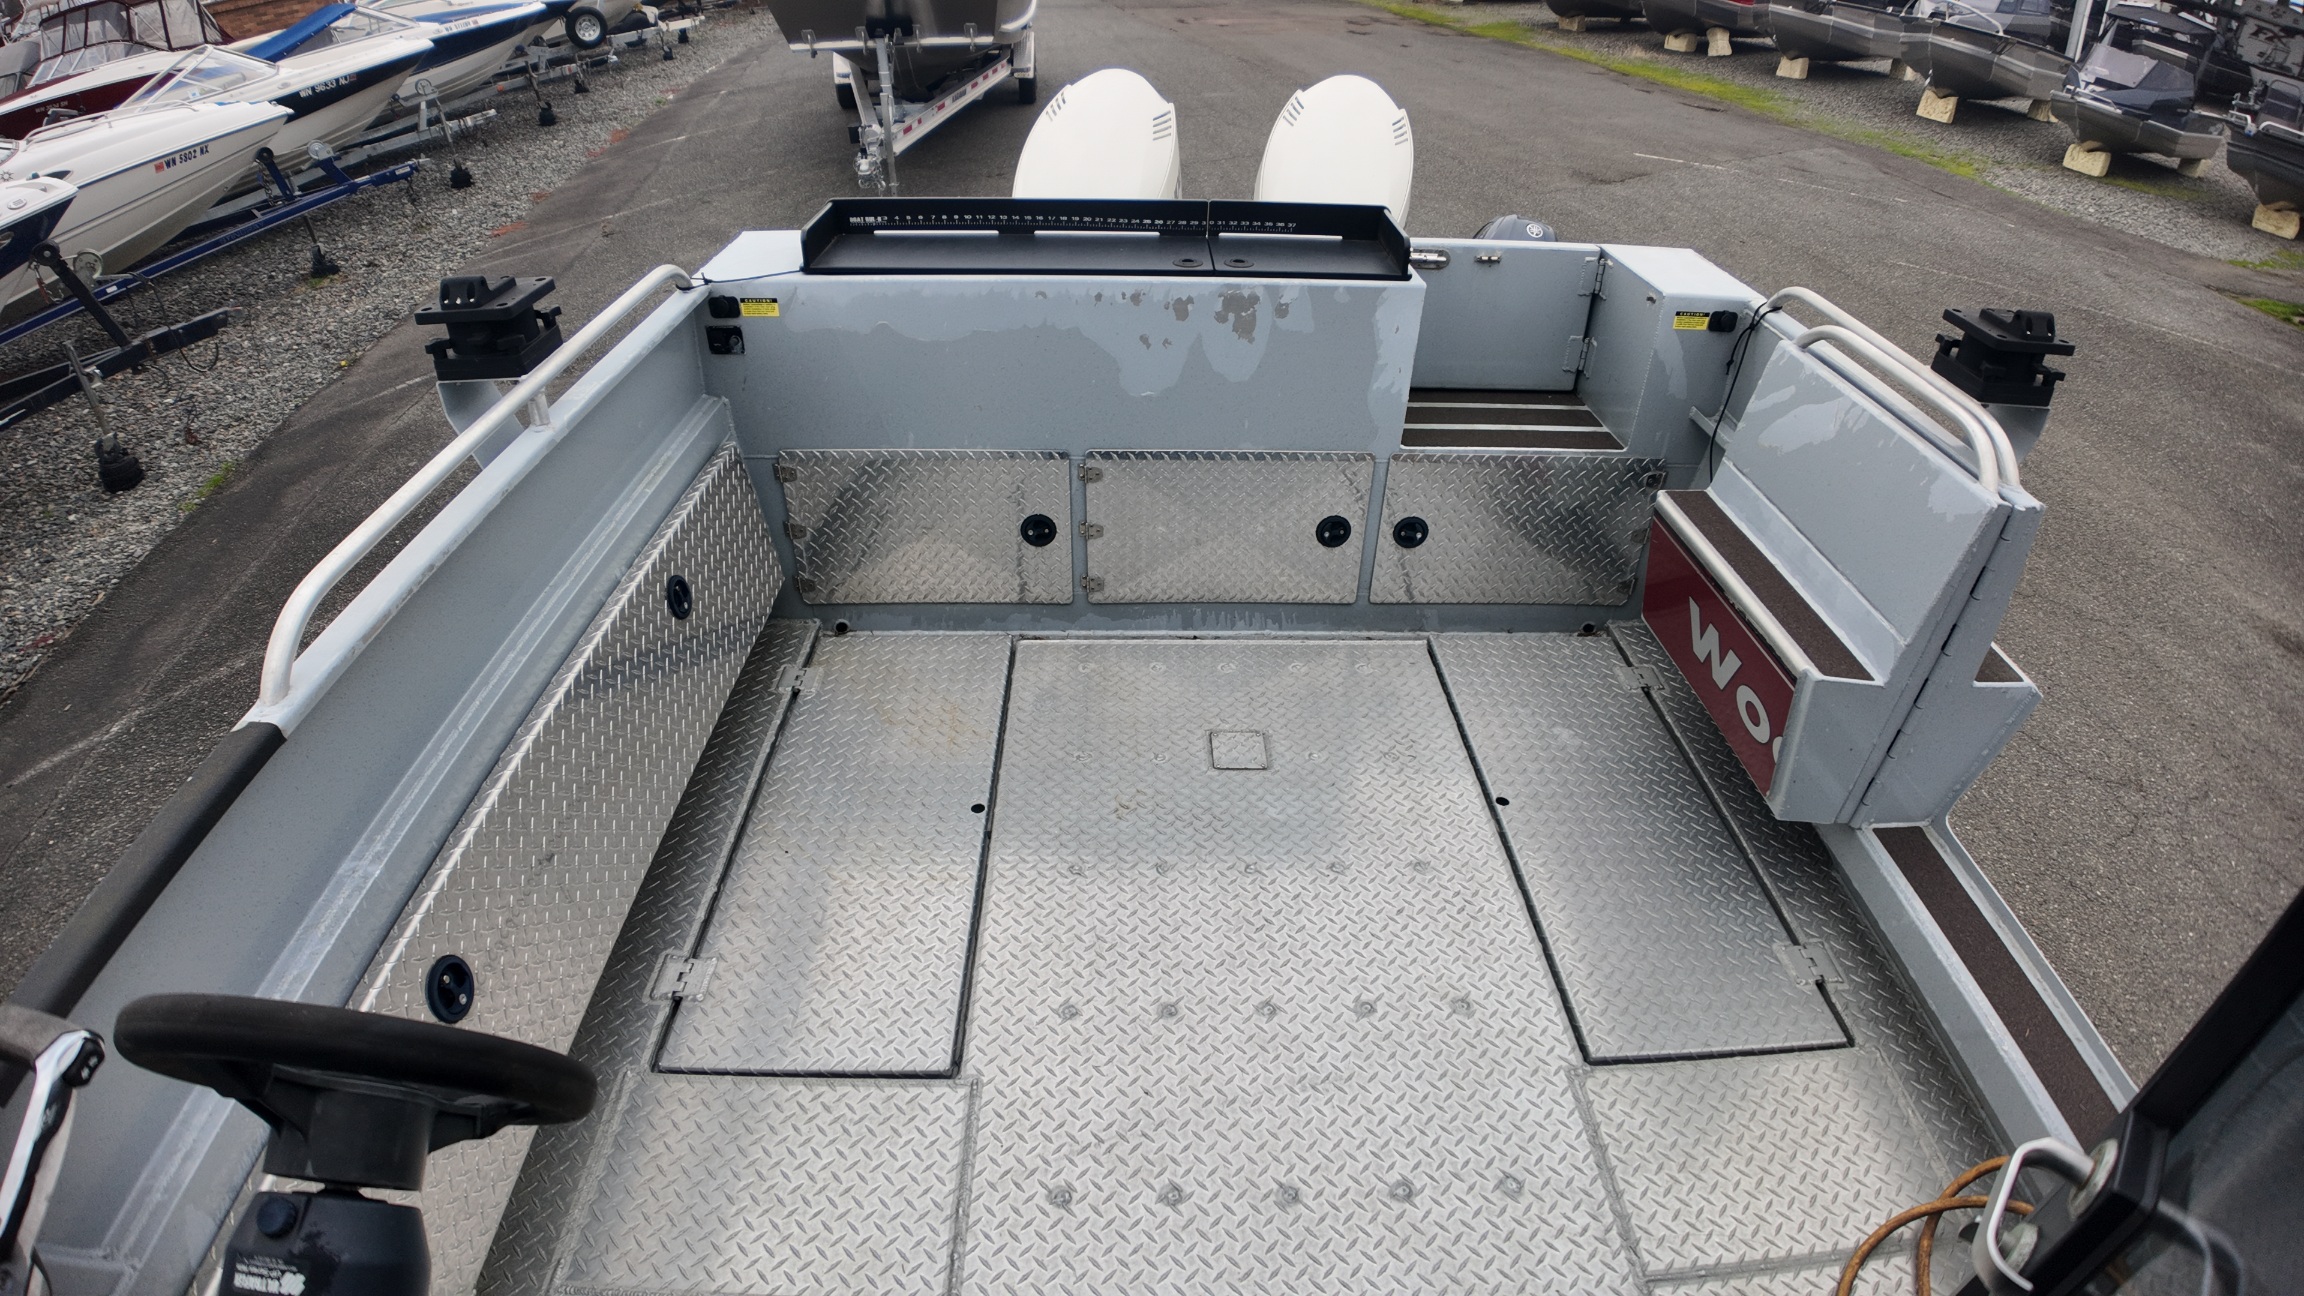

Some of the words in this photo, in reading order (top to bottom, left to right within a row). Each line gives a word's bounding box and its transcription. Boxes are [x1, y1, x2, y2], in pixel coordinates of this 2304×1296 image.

[299, 86, 312, 98] WN
[339, 75, 350, 86] NJ
[164, 156, 177, 169] WN
[200, 144, 209, 156] NX
